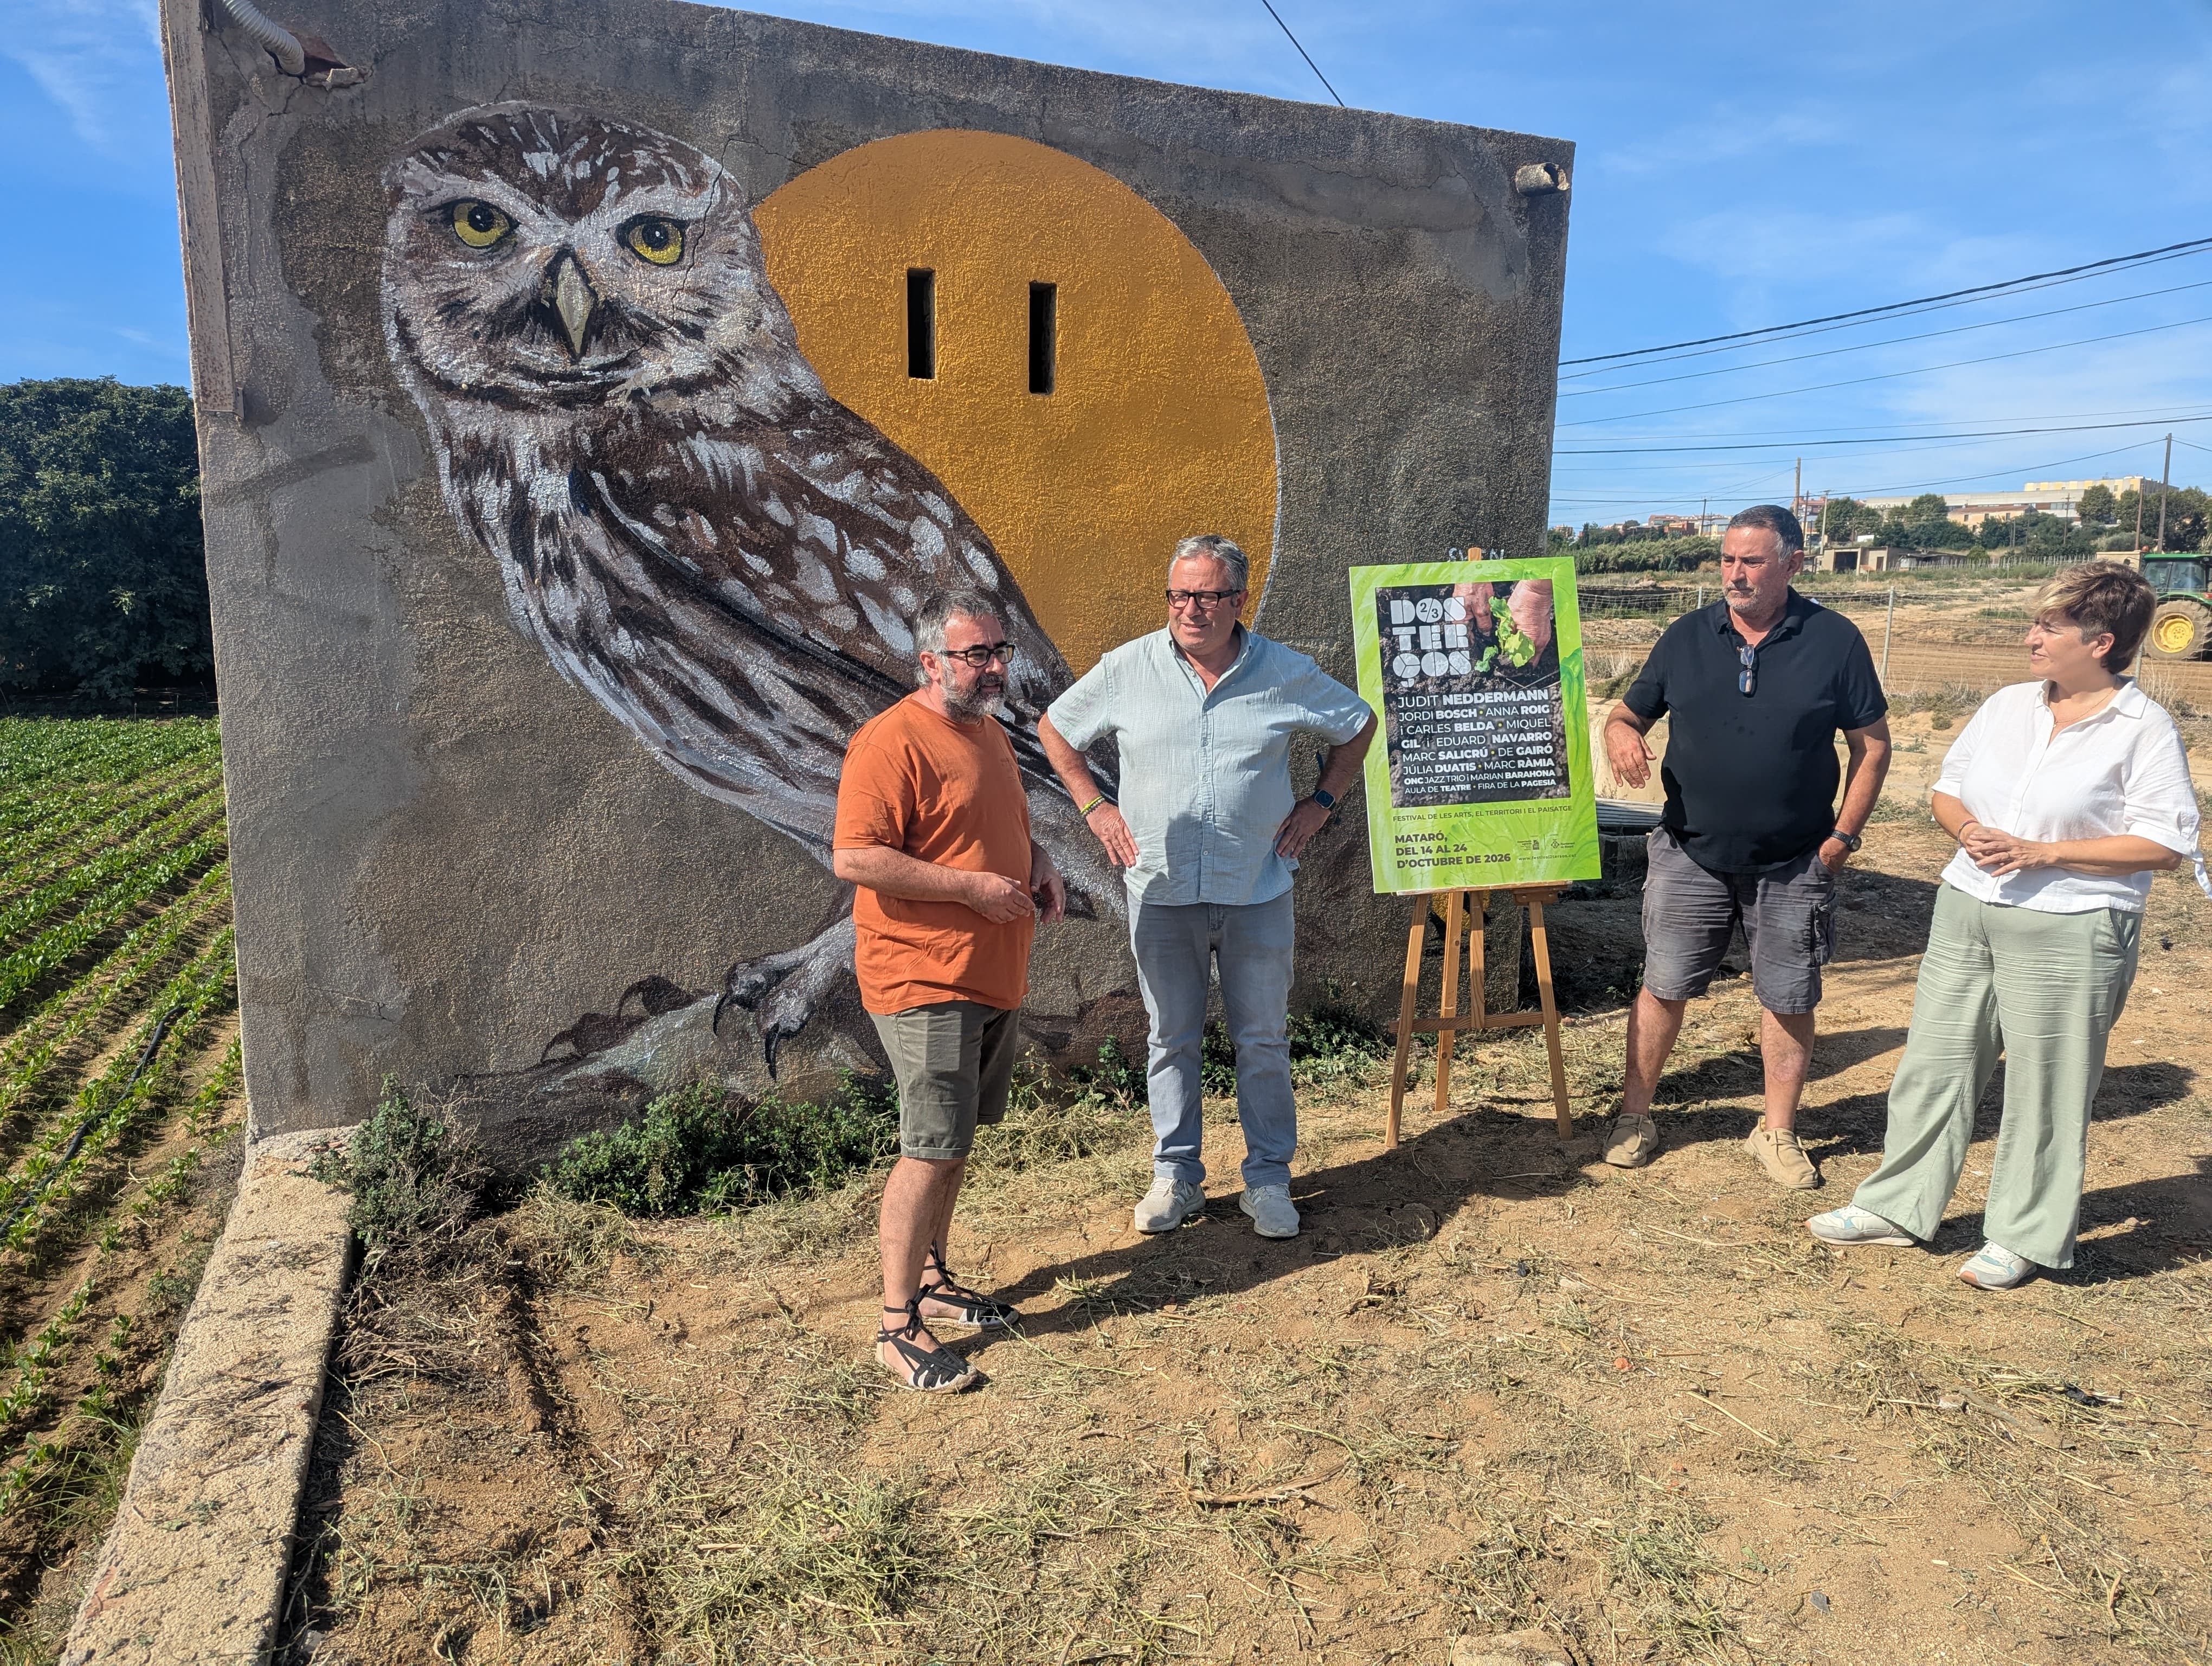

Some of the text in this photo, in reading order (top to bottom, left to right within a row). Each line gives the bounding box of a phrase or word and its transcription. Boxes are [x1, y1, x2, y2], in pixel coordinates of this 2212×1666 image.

[1390, 597, 1466, 624] DOS
[1392, 624, 1468, 651] TER
[1393, 651, 1471, 687] ÇOS
[1398, 689, 1548, 708] JUDIT NEDDERMANN
[1399, 704, 1549, 722] JORDI BOSCH ANNA ROIG
[1406, 723, 1451, 734] CARLES
[1454, 721, 1495, 732] BELDA
[1506, 718, 1551, 729] MIQUEL
[1401, 739, 1420, 748] GIL
[1437, 735, 1486, 747] EDUARD
[1492, 732, 1552, 744] NAVARRO
[1403, 743, 1553, 762] MARC SALICRÚ DE GAIRÓ
[1403, 757, 1555, 775] JÚLIA DUATIS MARC RÀMIA
[1470, 772, 1504, 780] MARIAN
[1505, 770, 1556, 779] BARAHONA
[1395, 830, 1448, 843] MATARÓ,
[1396, 844, 1468, 856] DEL 14 AL 24
[1397, 853, 1511, 869] D’OCTUBRE DE 2026
